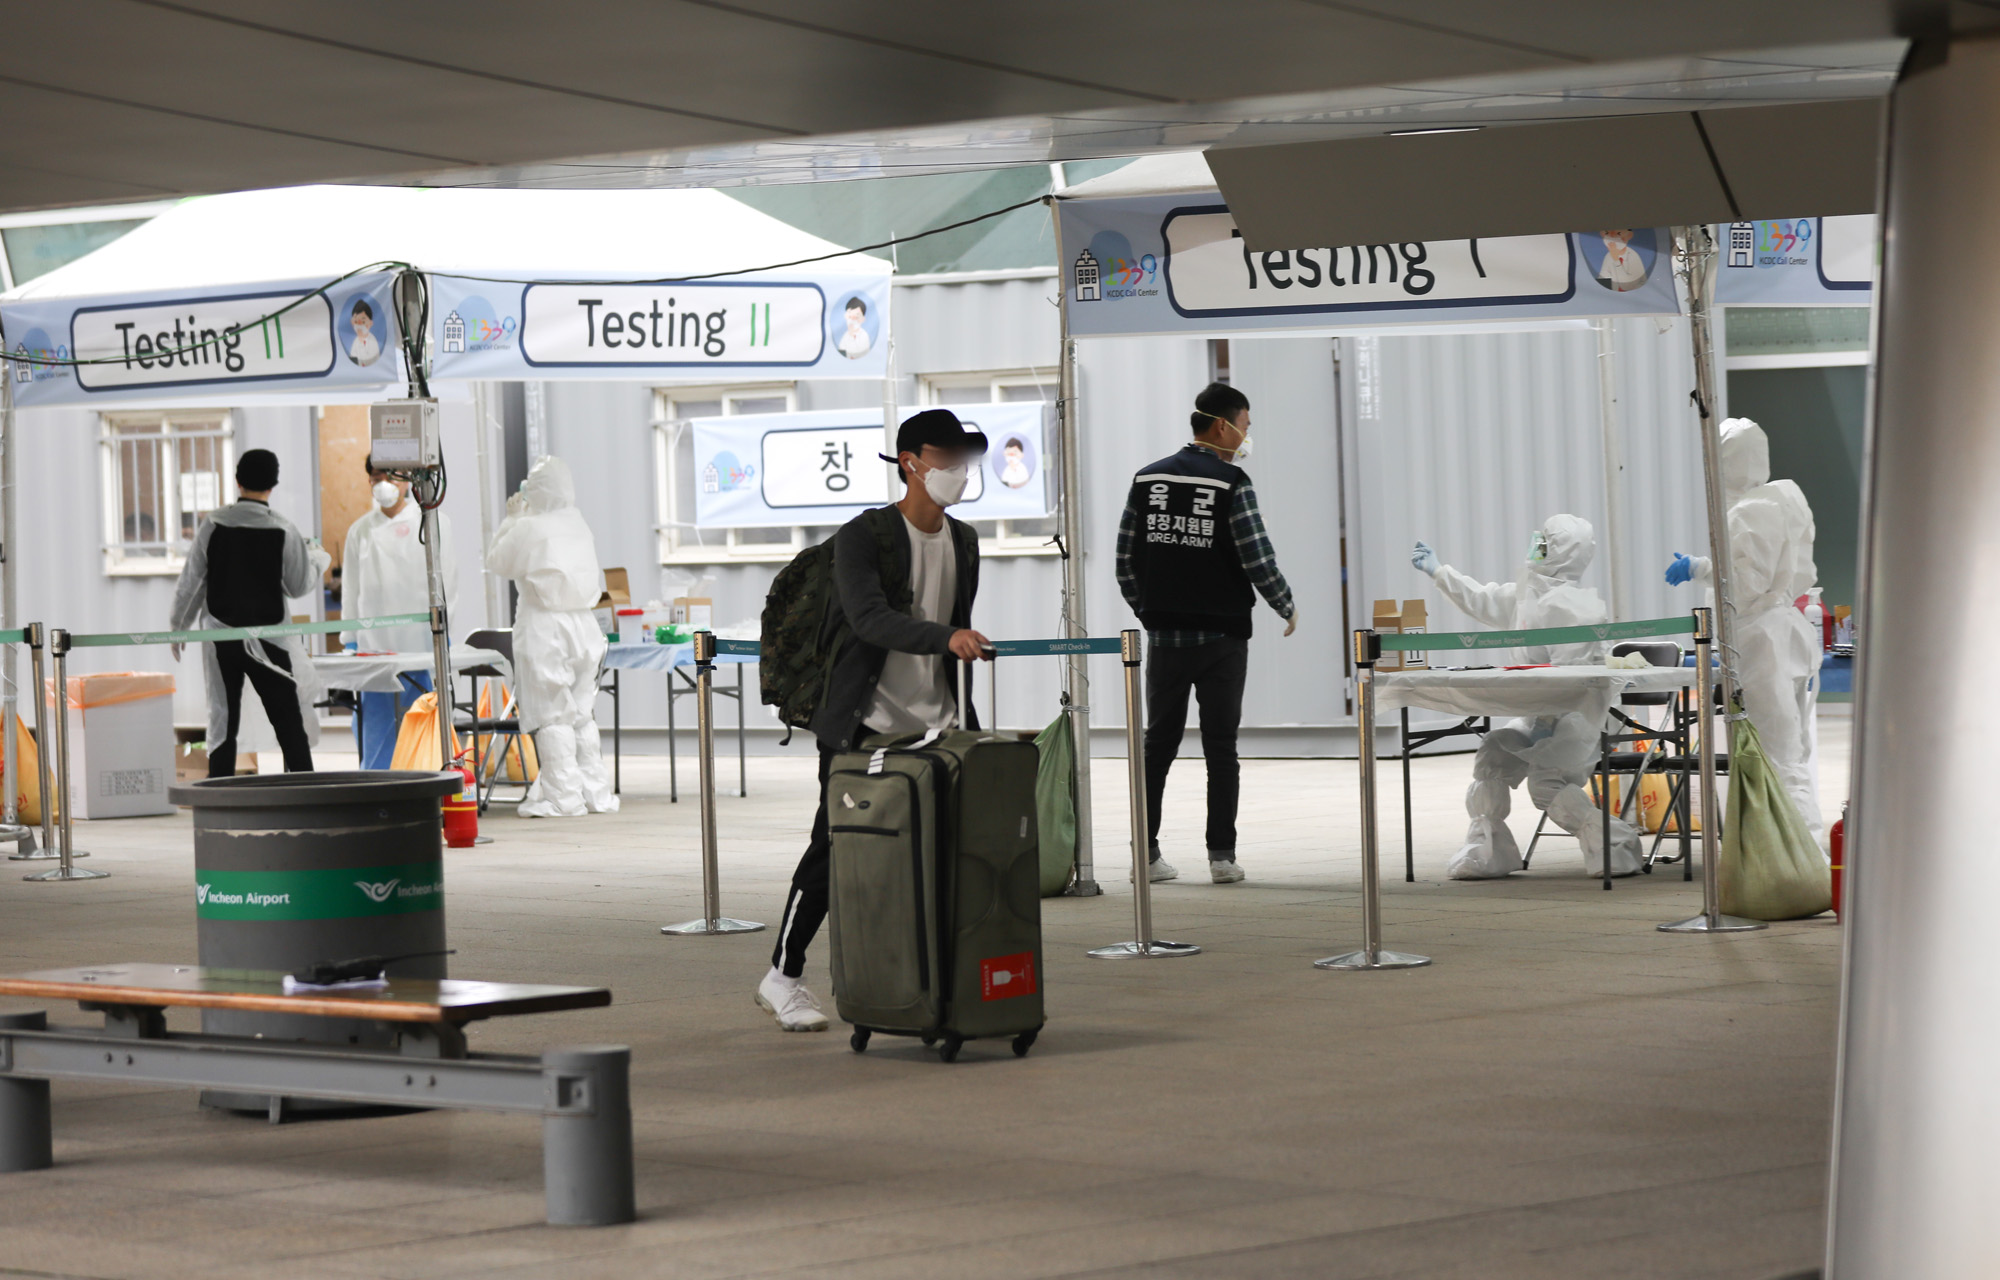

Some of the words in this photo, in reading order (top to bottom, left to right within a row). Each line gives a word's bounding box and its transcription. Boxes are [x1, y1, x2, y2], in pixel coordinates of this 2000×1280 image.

[1759, 219, 1811, 252] 1339
[1105, 254, 1157, 286] 1339
[1788, 256, 1809, 265] Center
[1106, 289, 1125, 298] KCDC
[1125, 289, 1137, 297] Call
[1137, 288, 1159, 297] Center
[469, 316, 516, 342] 1339
[578, 297, 727, 357] Testing
[115, 315, 246, 373] Testing
[820, 442, 853, 492] 창
[1146, 532, 1179, 545] KOREA
[1180, 535, 1214, 549] ARMY
[1049, 643, 1067, 652] SMART
[1067, 643, 1091, 651] Check-In
[208, 891, 243, 904] Incheon
[246, 892, 290, 907] Airport
